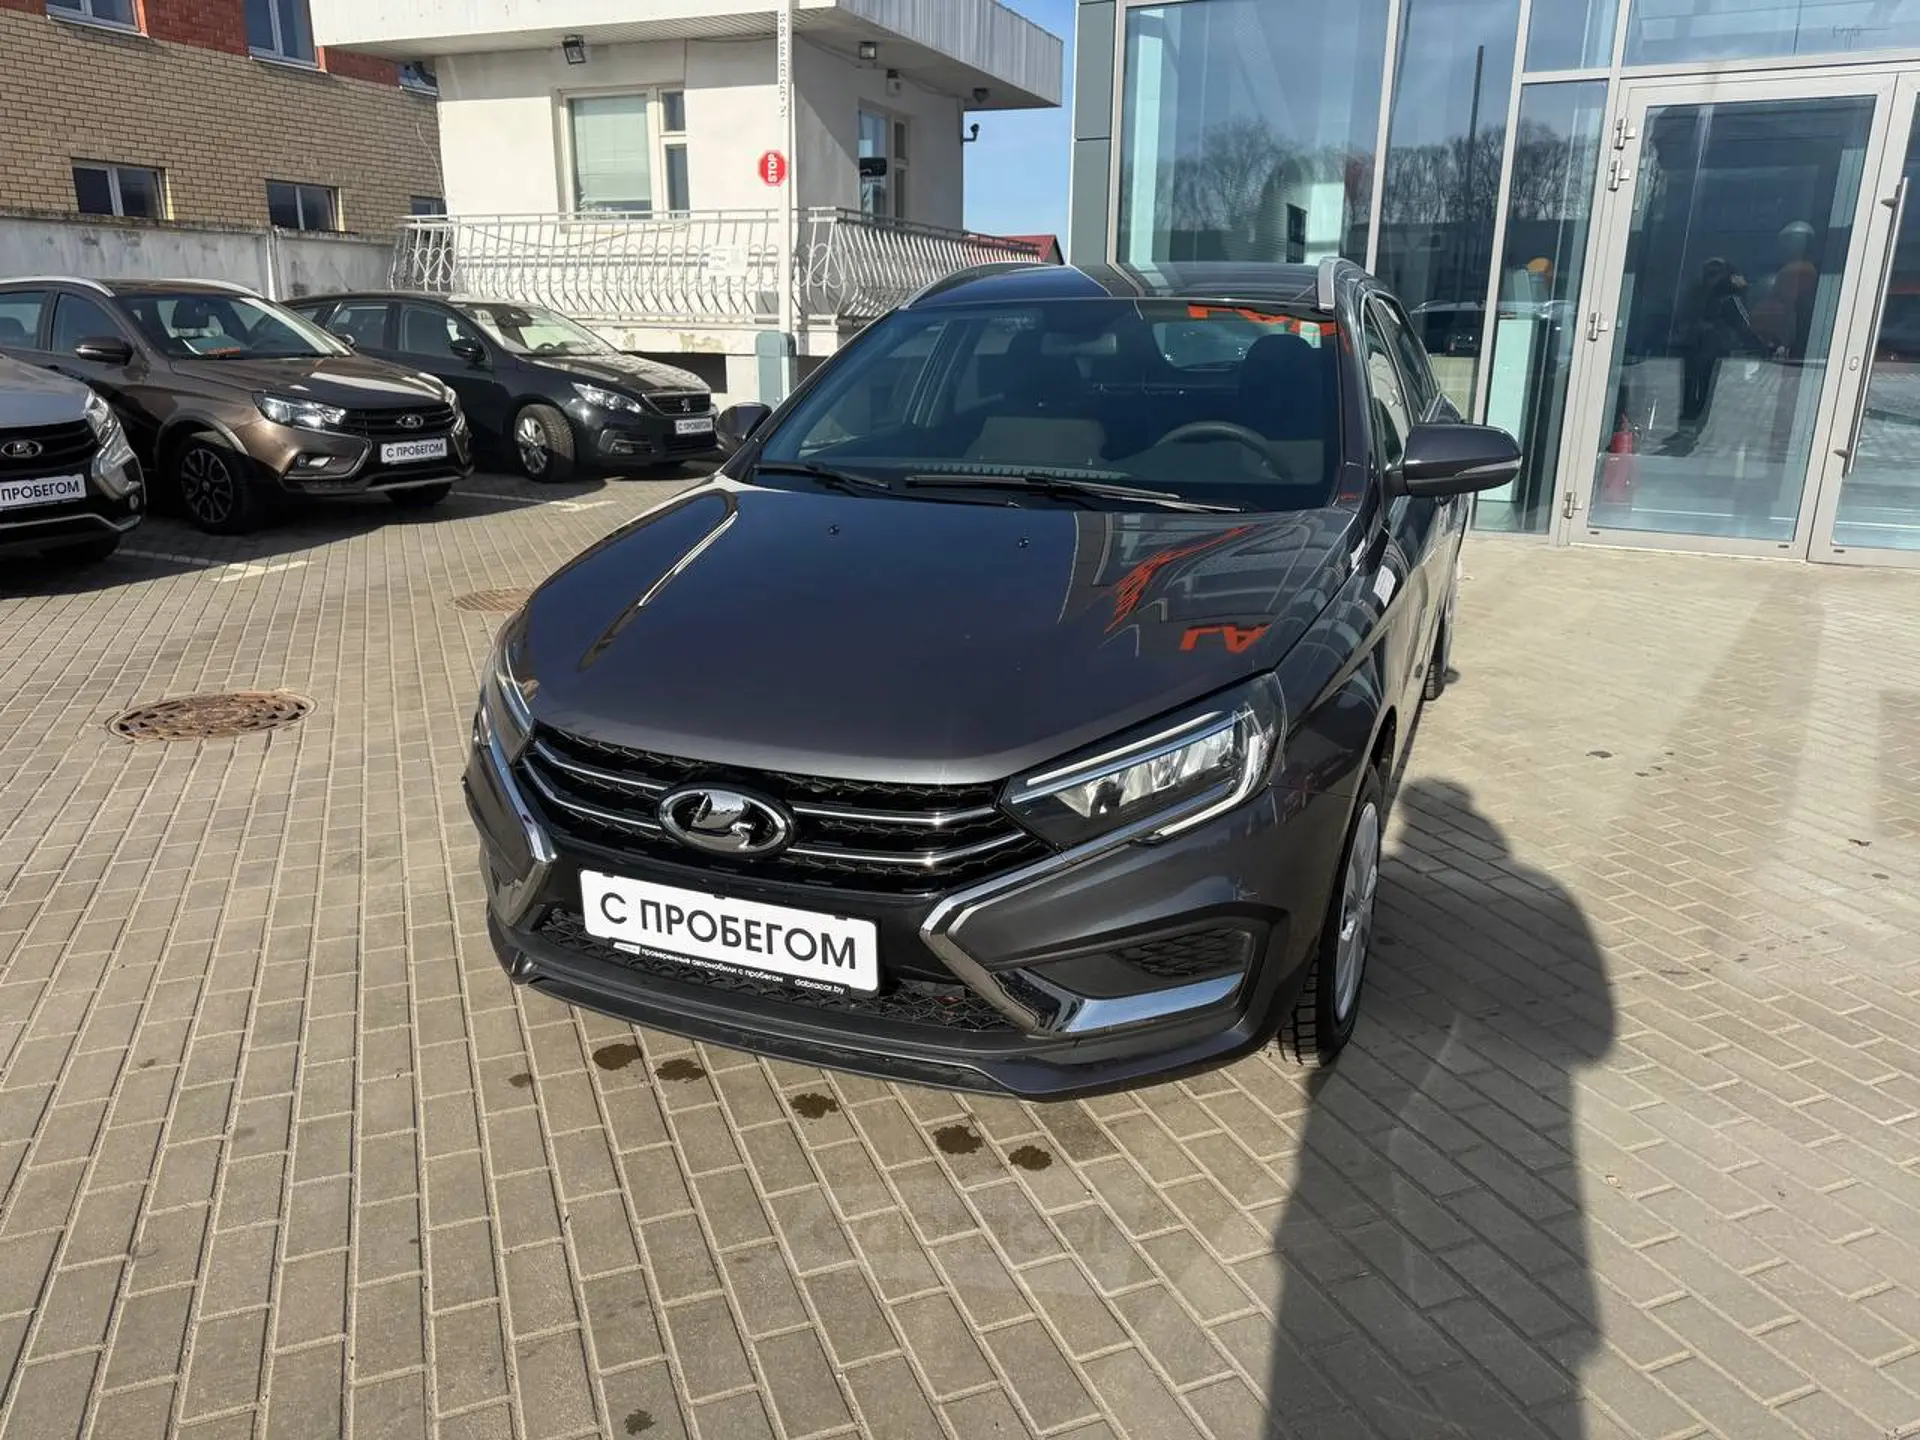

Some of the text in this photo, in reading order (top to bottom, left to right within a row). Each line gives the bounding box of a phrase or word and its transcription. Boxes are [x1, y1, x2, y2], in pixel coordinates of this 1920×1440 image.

[767, 153, 778, 182] STOP
[386, 443, 443, 458] С ПРОБЕГОМ
[1, 480, 80, 501] ПРОБЕГОМ
[600, 891, 856, 970] С ПРОБЕГОМ
[692, 959, 737, 974] автомобили
[745, 969, 784, 983] пробегом
